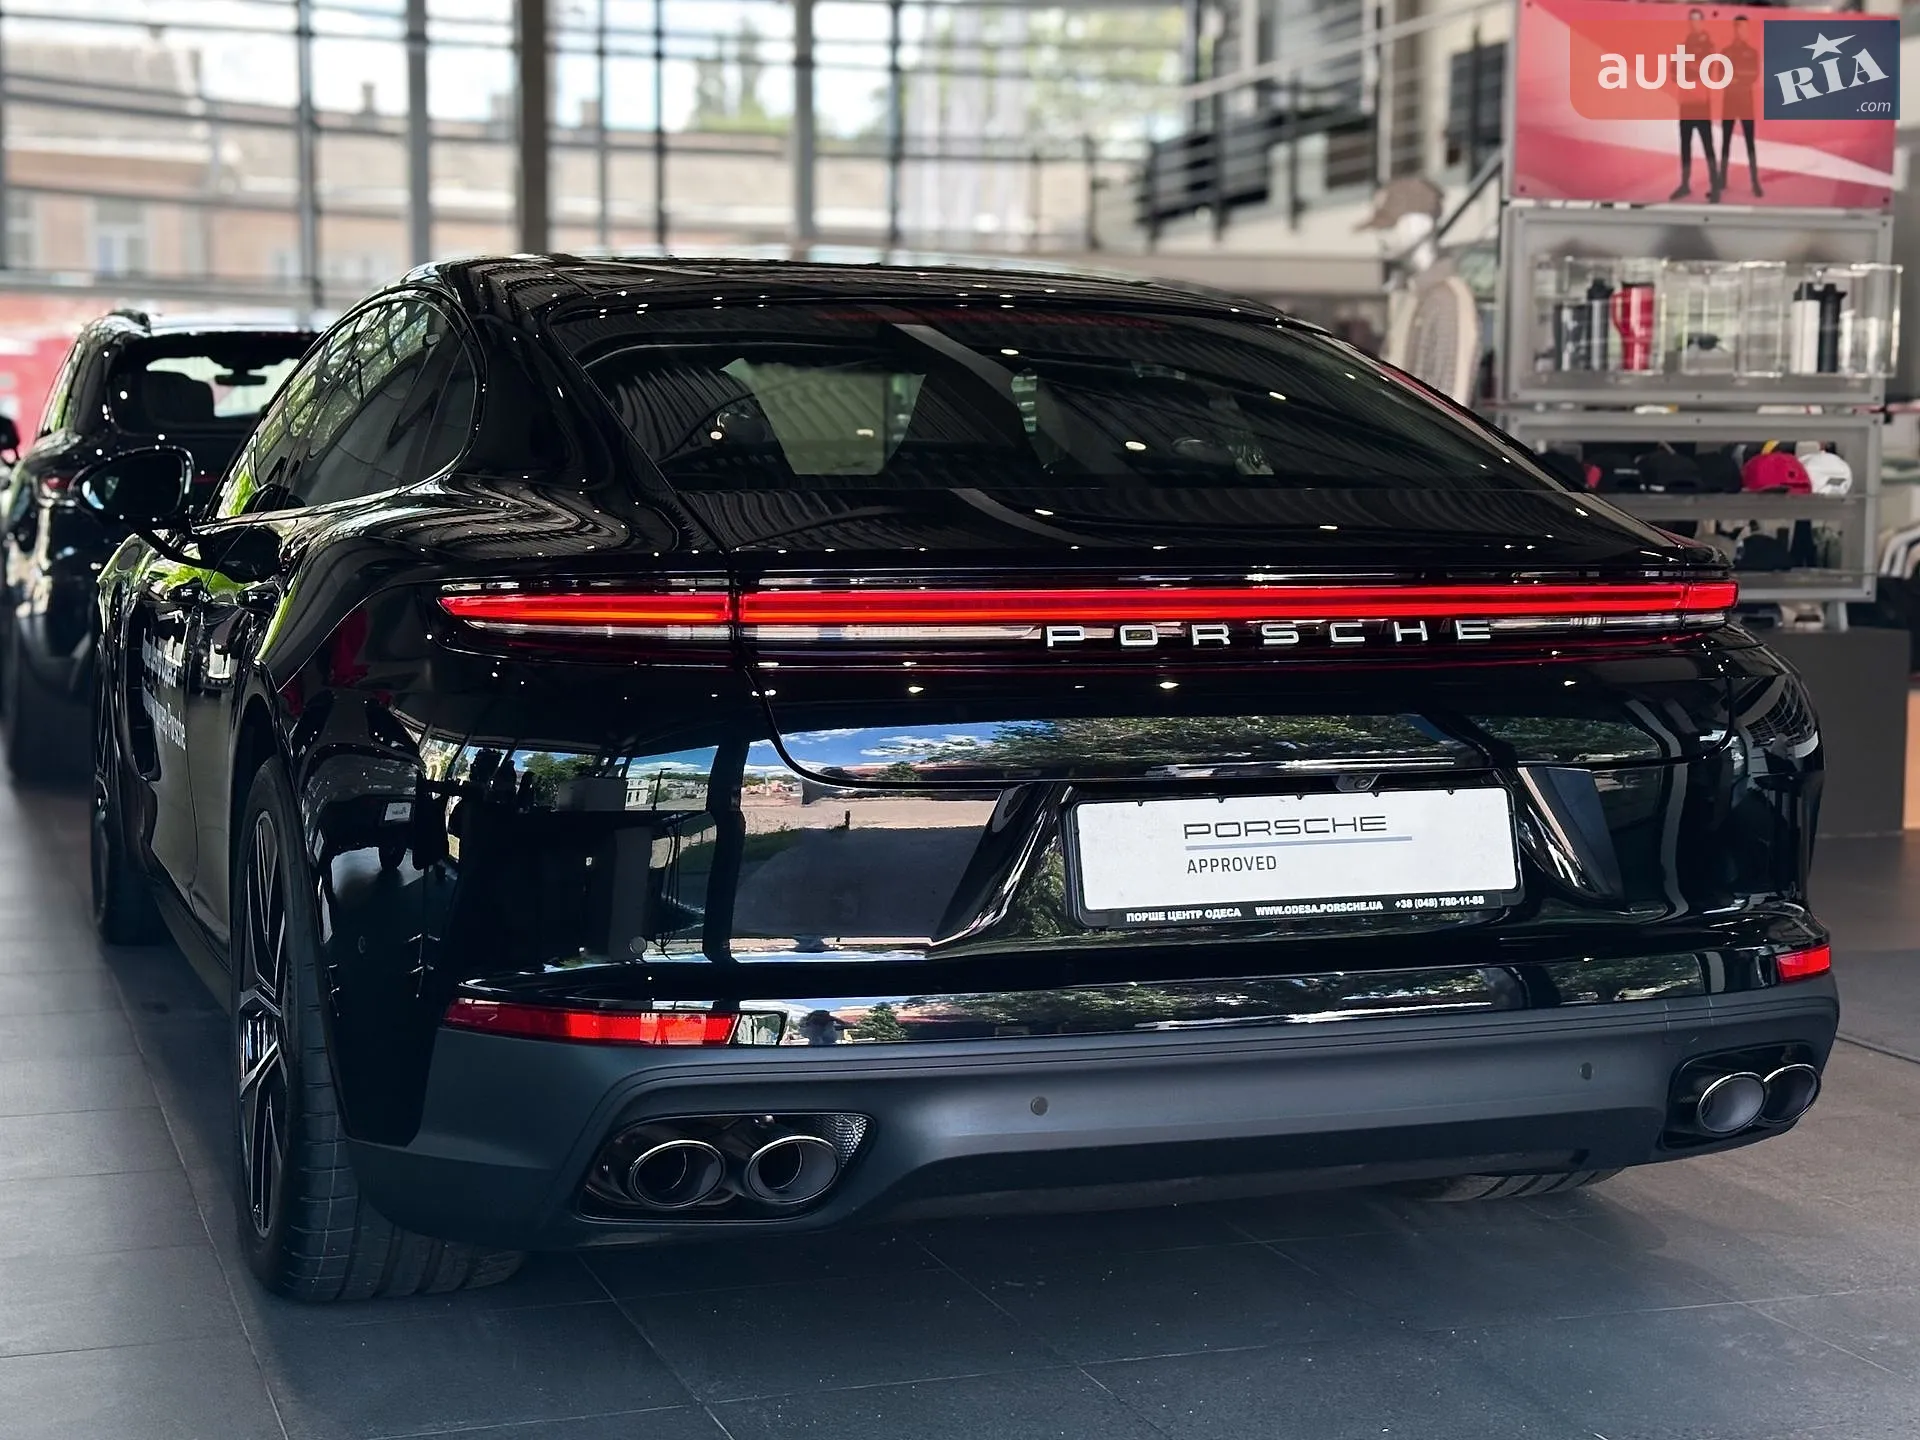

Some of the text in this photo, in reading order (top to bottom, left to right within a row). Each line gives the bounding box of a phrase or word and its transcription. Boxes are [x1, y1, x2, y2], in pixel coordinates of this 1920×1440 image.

[1046, 618, 1492, 648] PORSCHE
[1183, 815, 1387, 839] PORSCHE
[1187, 855, 1277, 874] APPROVED
[1255, 901, 1383, 916] WWW.ODESA.PORSCHE.UA
[1395, 899, 1413, 909] +38
[1126, 907, 1242, 922] ПОРШЕ ЦЕНТР ОДЕСА
